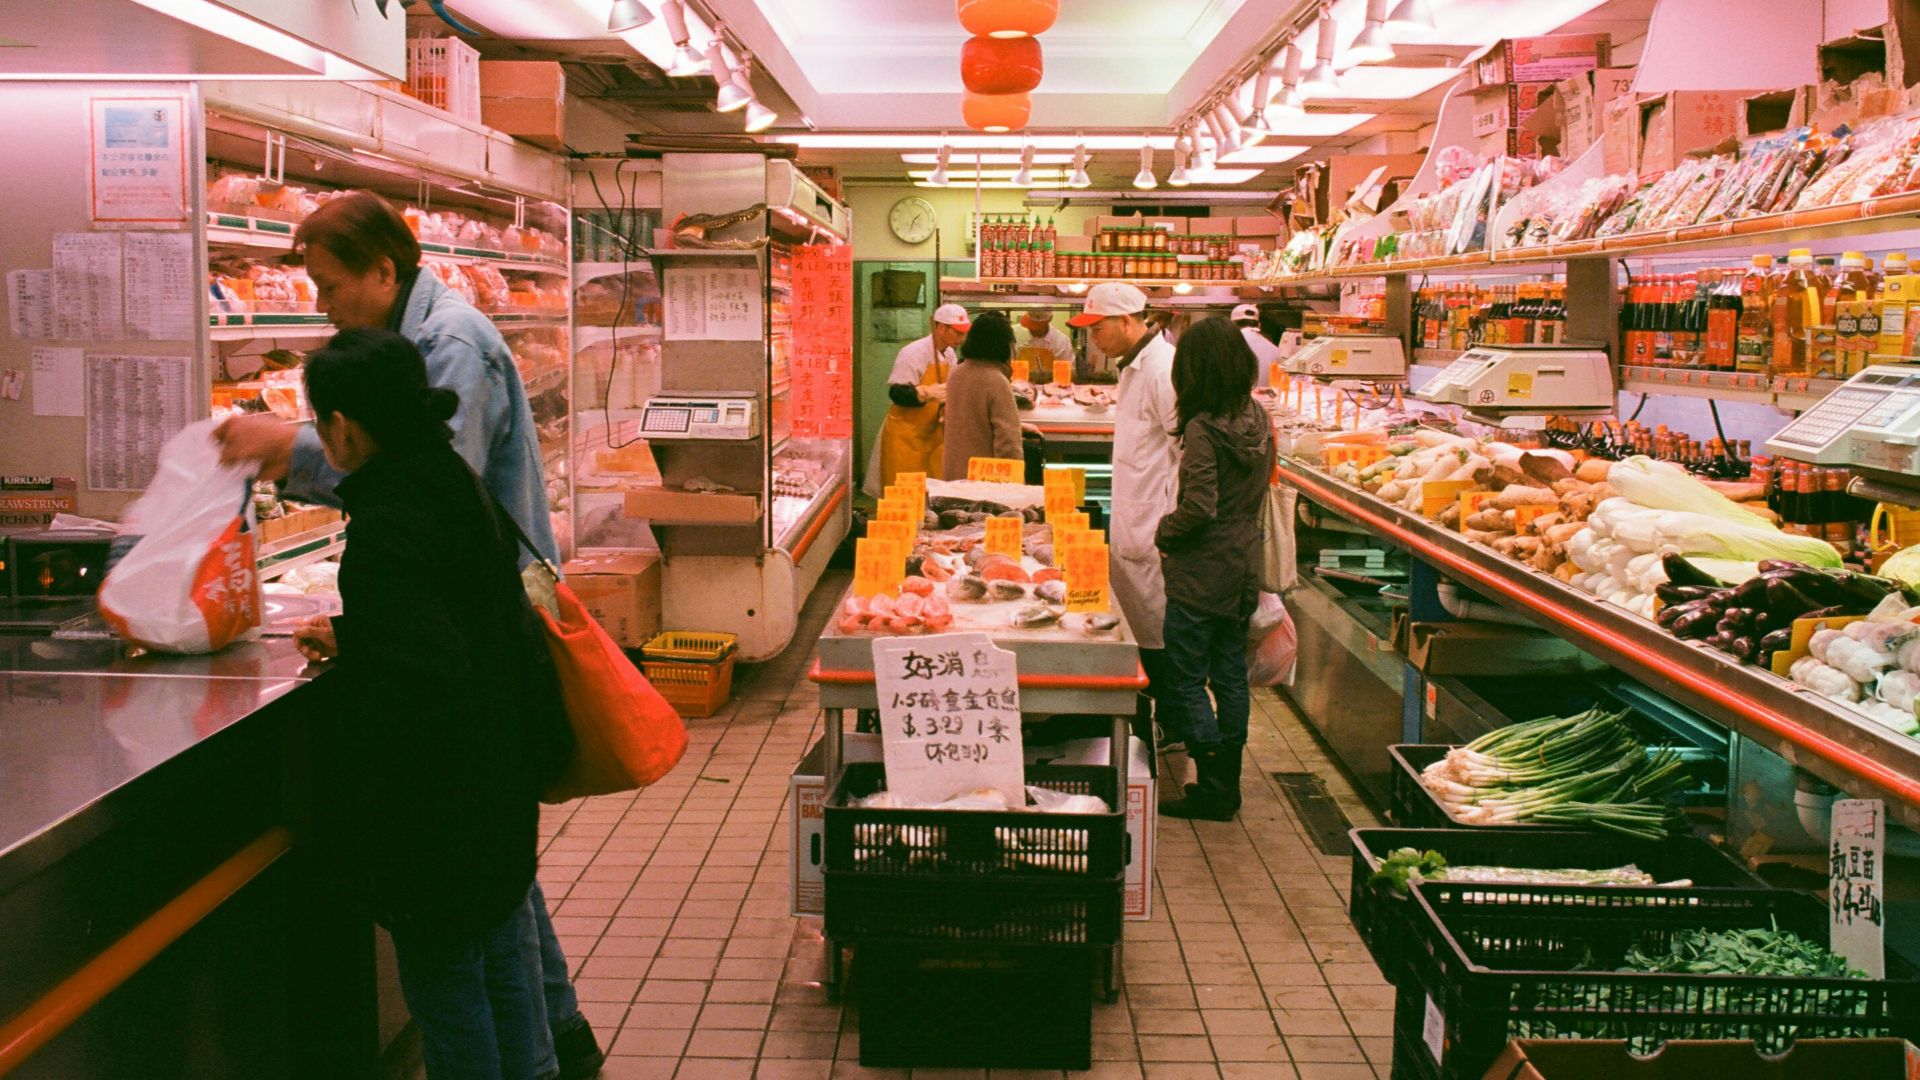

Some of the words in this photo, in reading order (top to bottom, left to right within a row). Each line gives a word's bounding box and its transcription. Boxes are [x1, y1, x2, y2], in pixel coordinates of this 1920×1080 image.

[1838, 319, 1858, 333] ARGO
[1860, 318, 1879, 332] ARGO
[4, 476, 51, 484] KIRKLAND
[0, 499, 69, 508] RAWSTRING
[0, 515, 38, 523] TCHEN
[900, 650, 999, 680] 好消息
